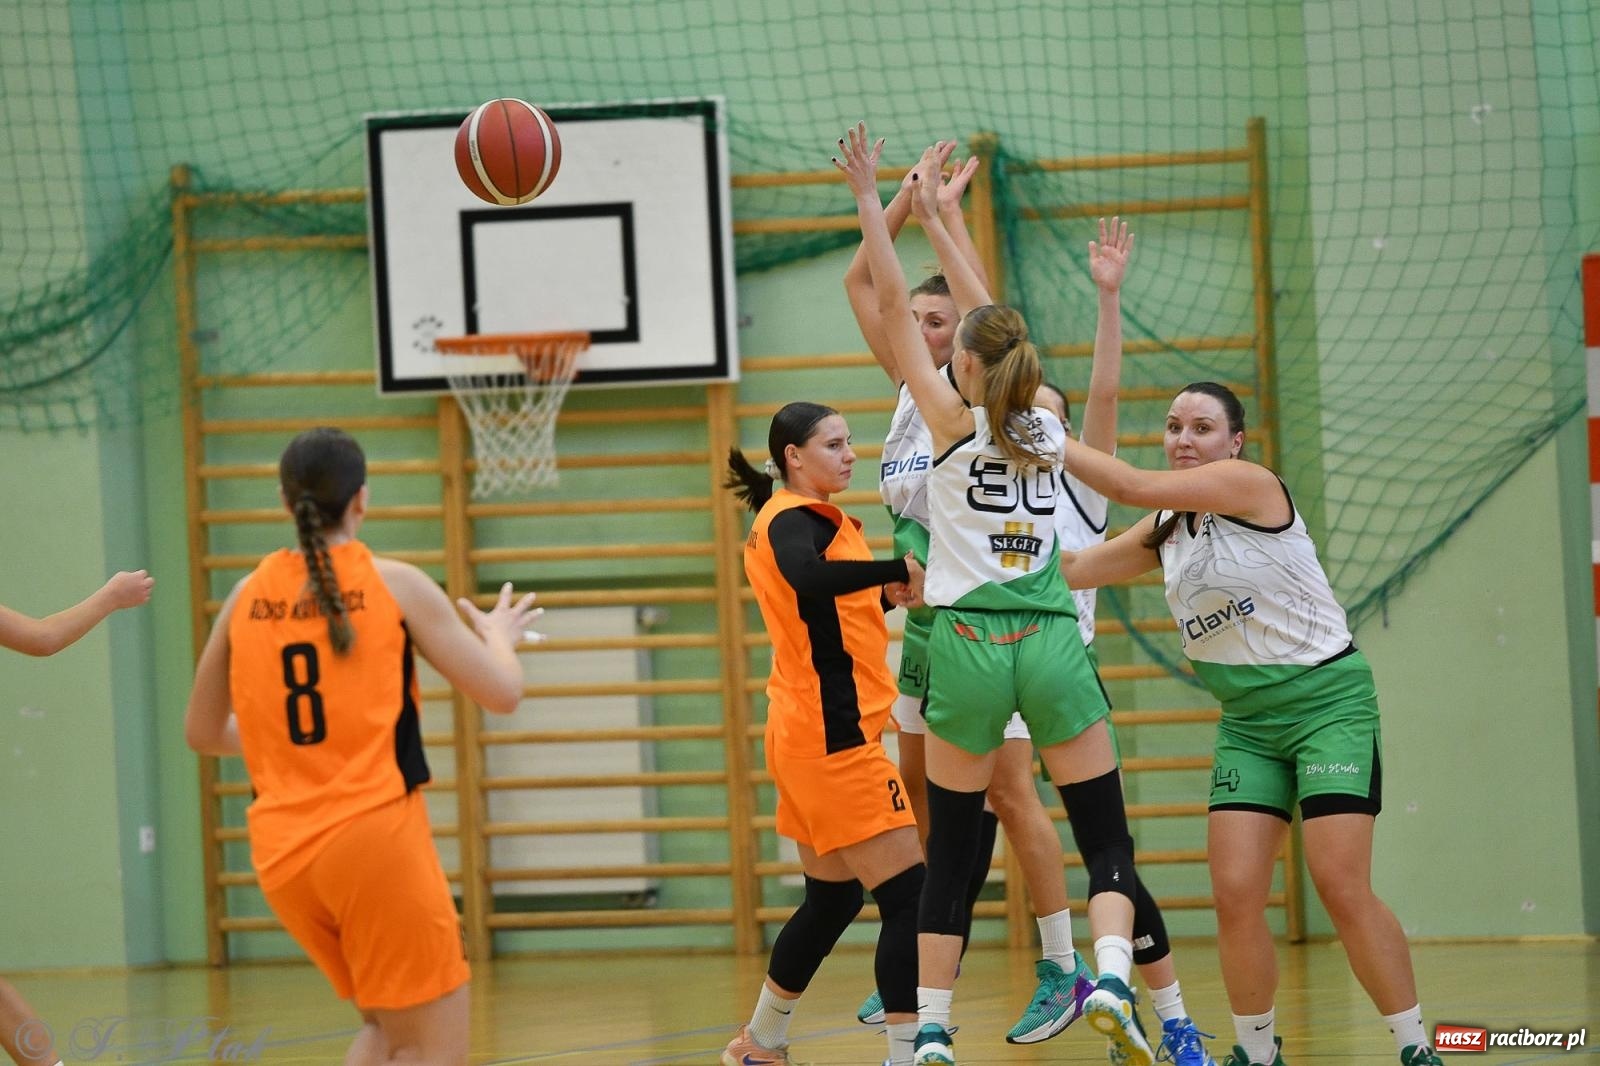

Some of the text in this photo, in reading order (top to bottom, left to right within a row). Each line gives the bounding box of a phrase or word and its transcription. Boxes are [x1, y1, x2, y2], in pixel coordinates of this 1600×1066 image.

[993, 537, 1039, 552] SEGET
[1186, 596, 1255, 640] Clavis
[282, 641, 326, 745] 8
[888, 779, 906, 812] 2
